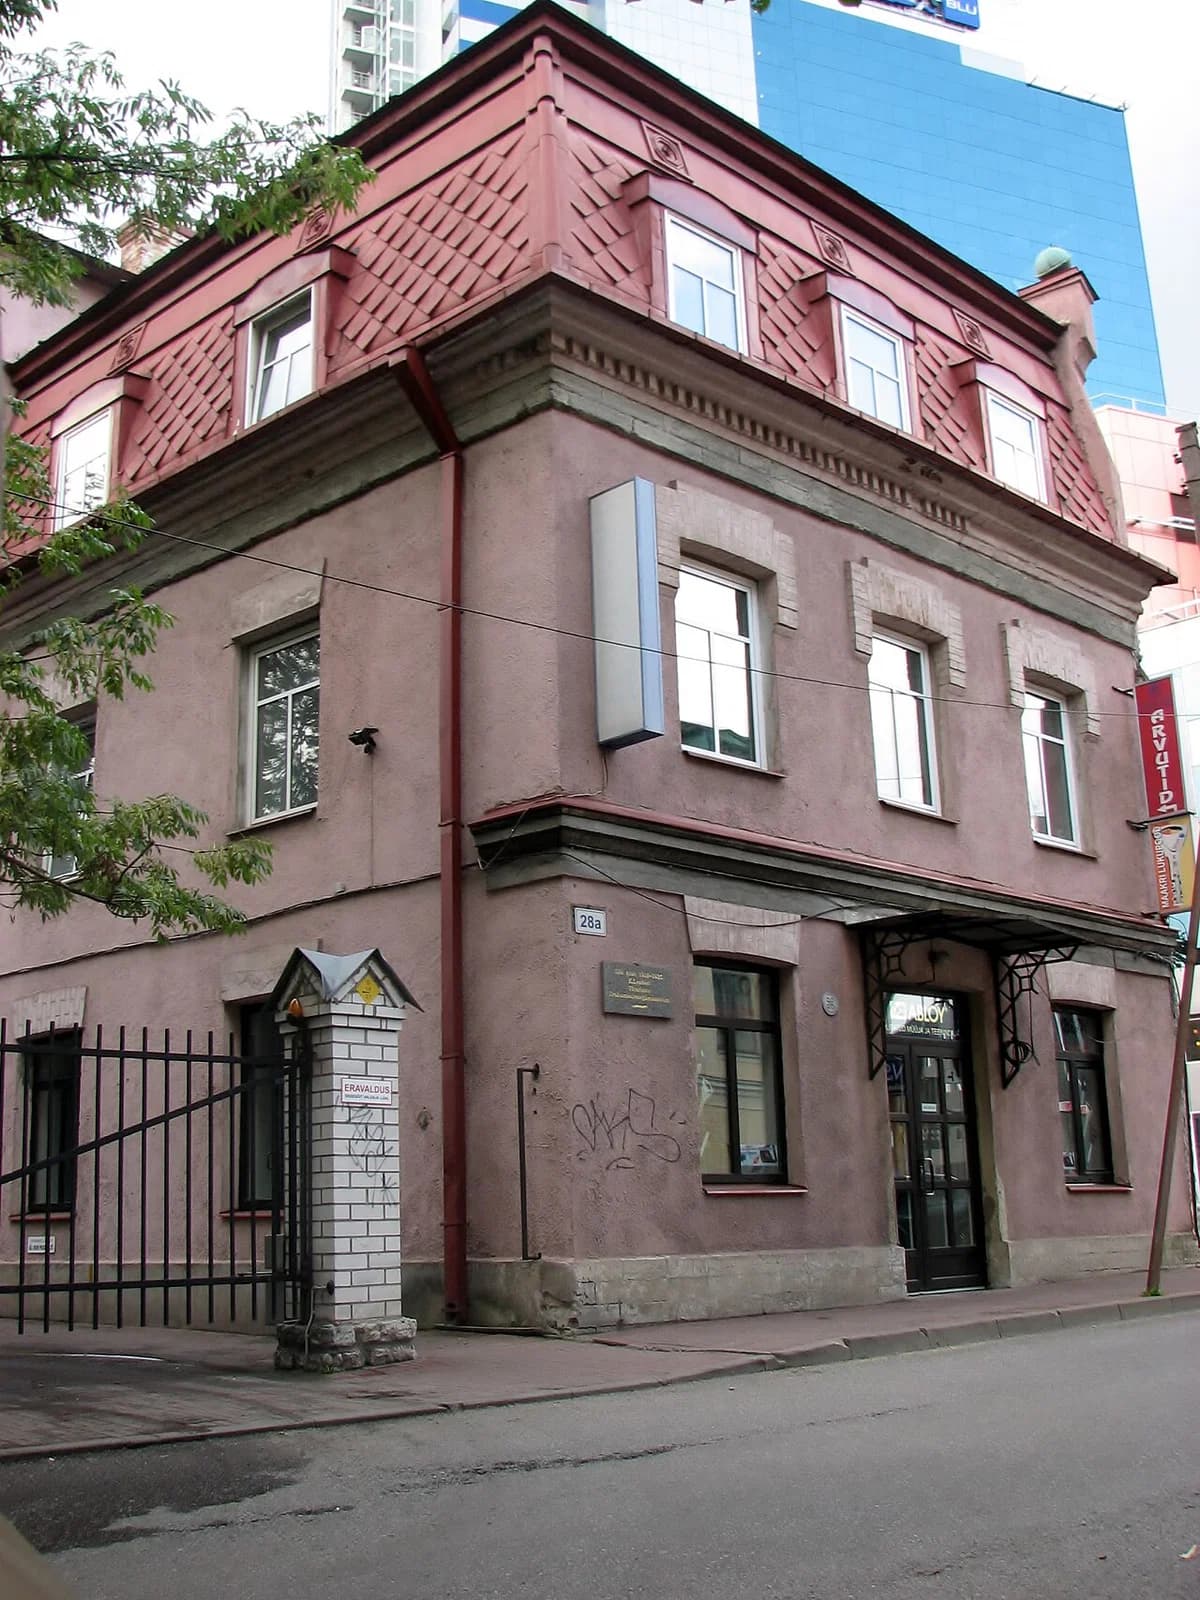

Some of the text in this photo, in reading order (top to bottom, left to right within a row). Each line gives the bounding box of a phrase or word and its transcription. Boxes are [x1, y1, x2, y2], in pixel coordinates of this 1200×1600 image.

[1150, 708, 1174, 805] ARVUTID
[1153, 826, 1169, 908] MAAKRI LUKUPOOD
[580, 914, 602, 930] 28a
[908, 1003, 946, 1024] ABLOY
[344, 1083, 390, 1094] ERAVALDUS
